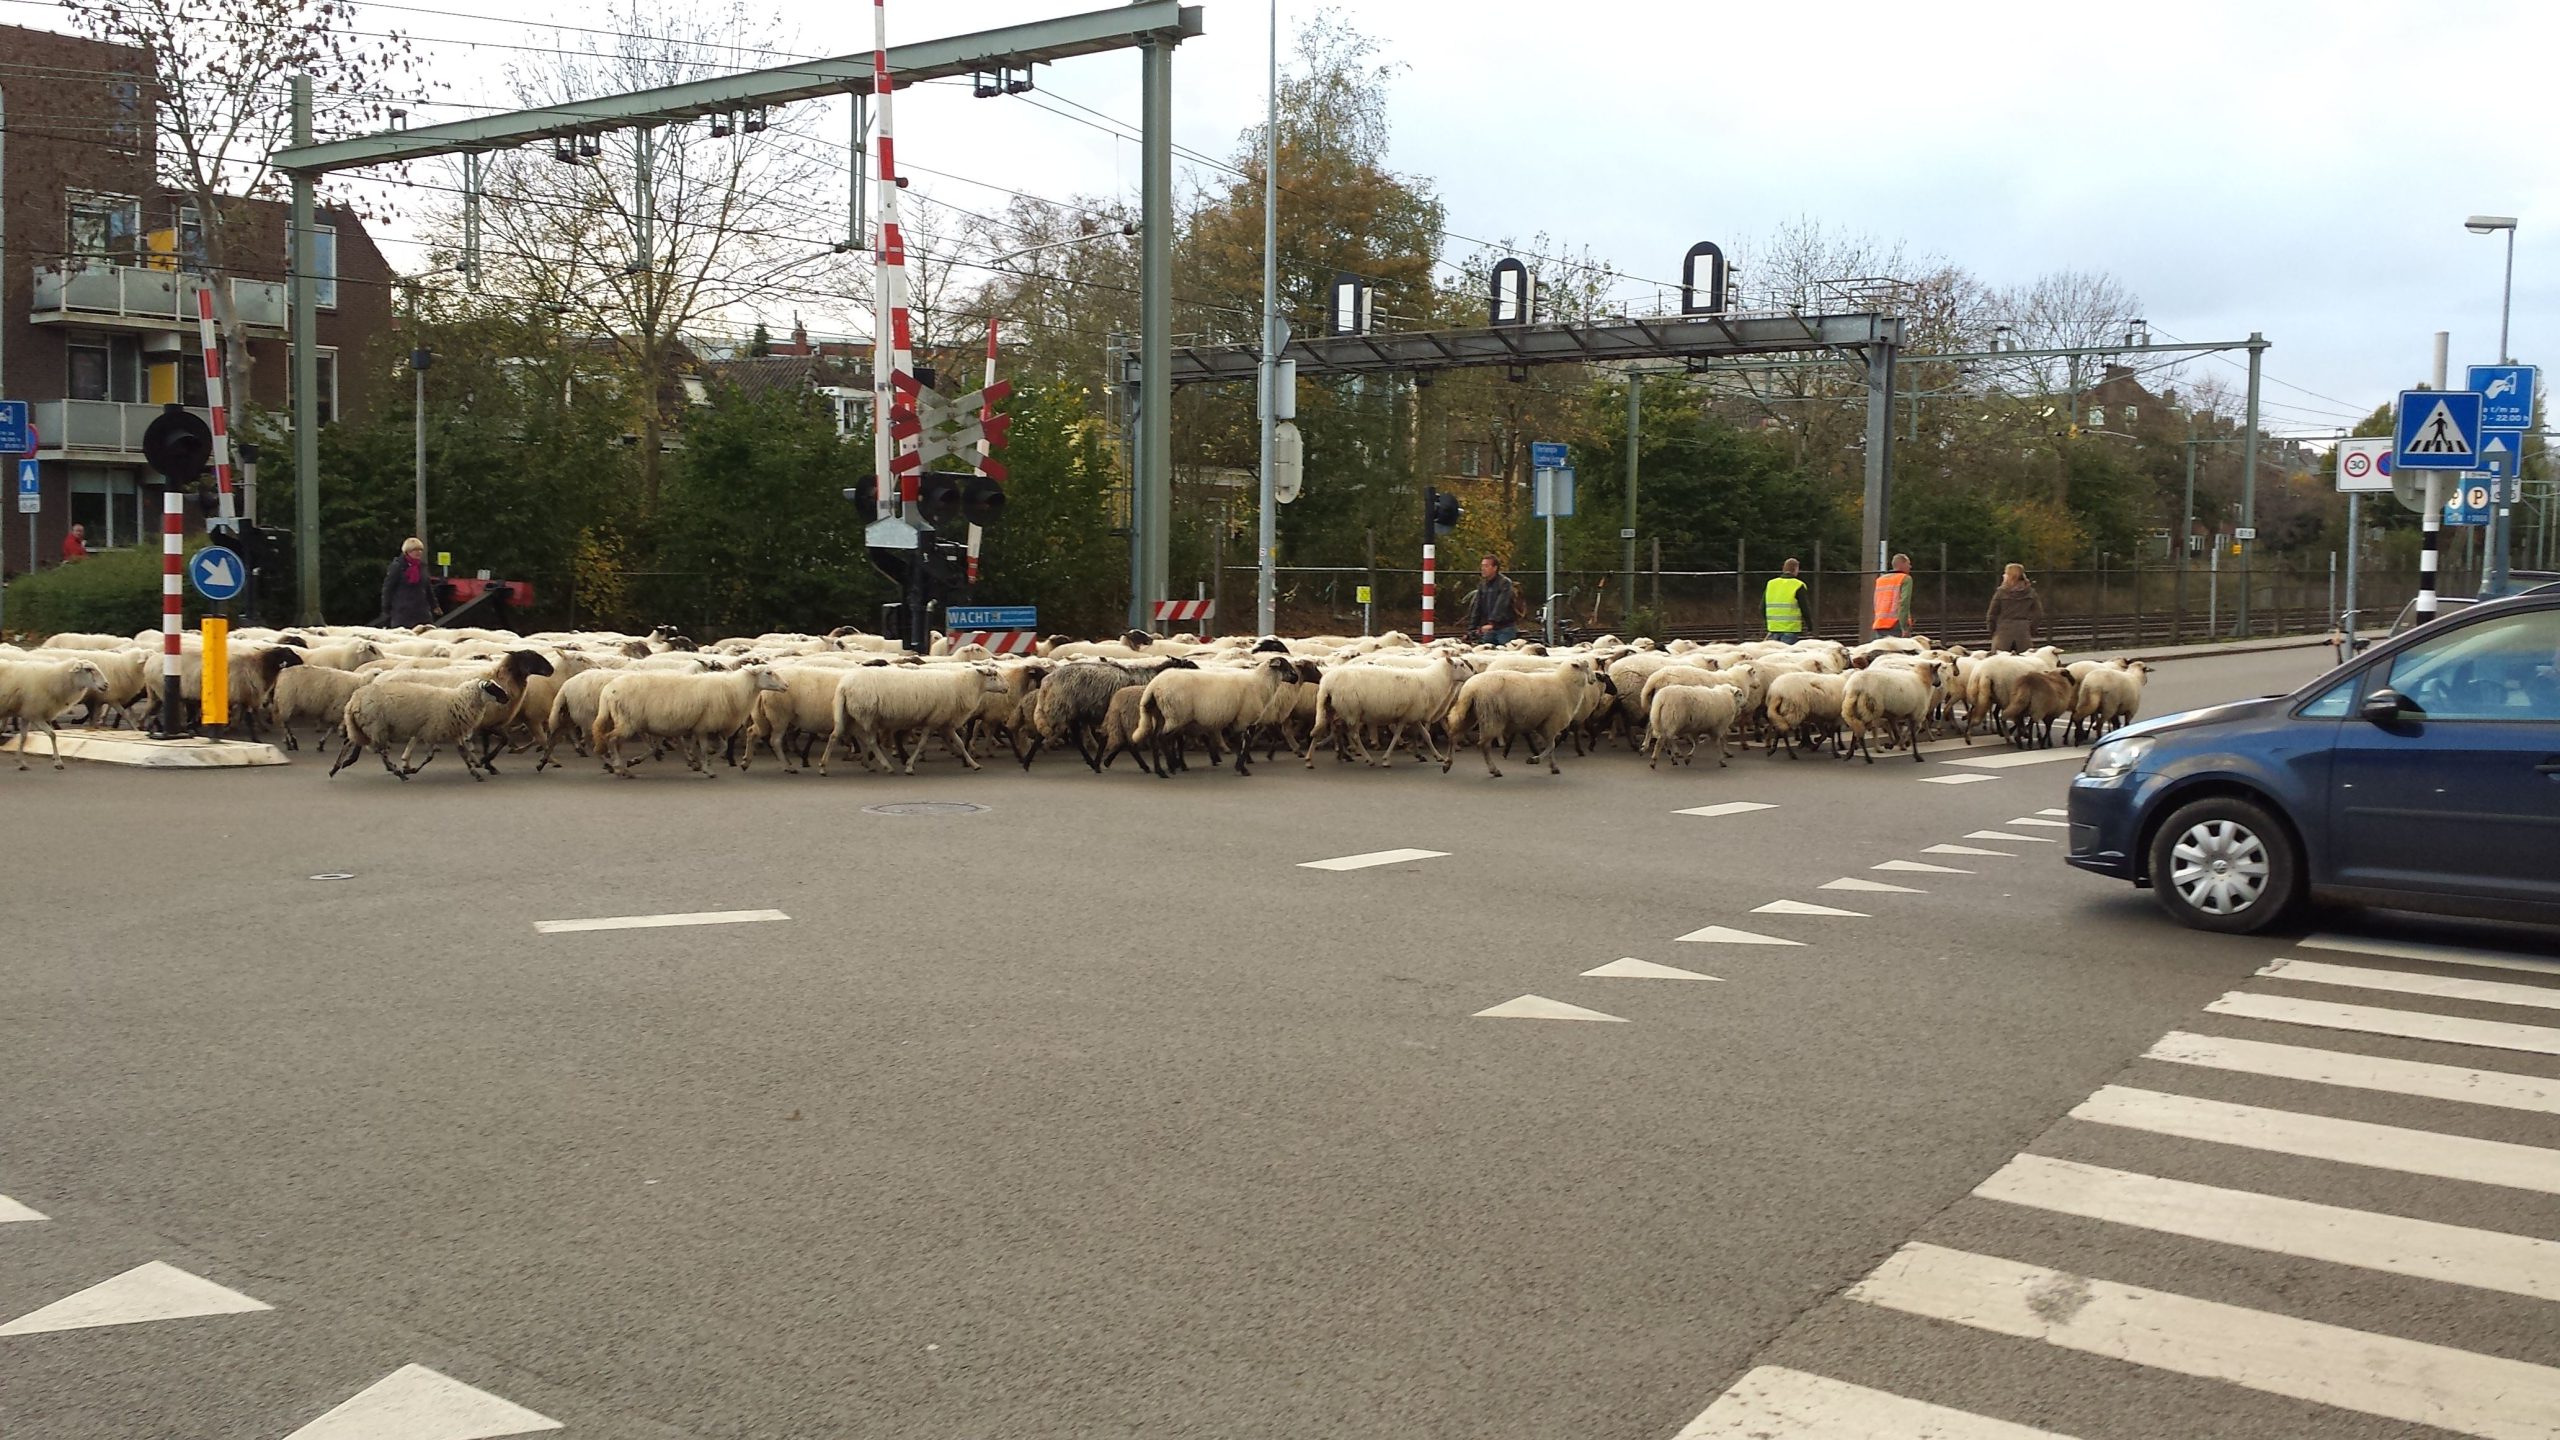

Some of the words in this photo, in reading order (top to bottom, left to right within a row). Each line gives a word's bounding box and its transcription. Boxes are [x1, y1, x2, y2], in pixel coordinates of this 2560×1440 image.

[2349, 460, 2366, 470] 30
[2473, 490, 2483, 505] P
[949, 611, 990, 623] WACHT
